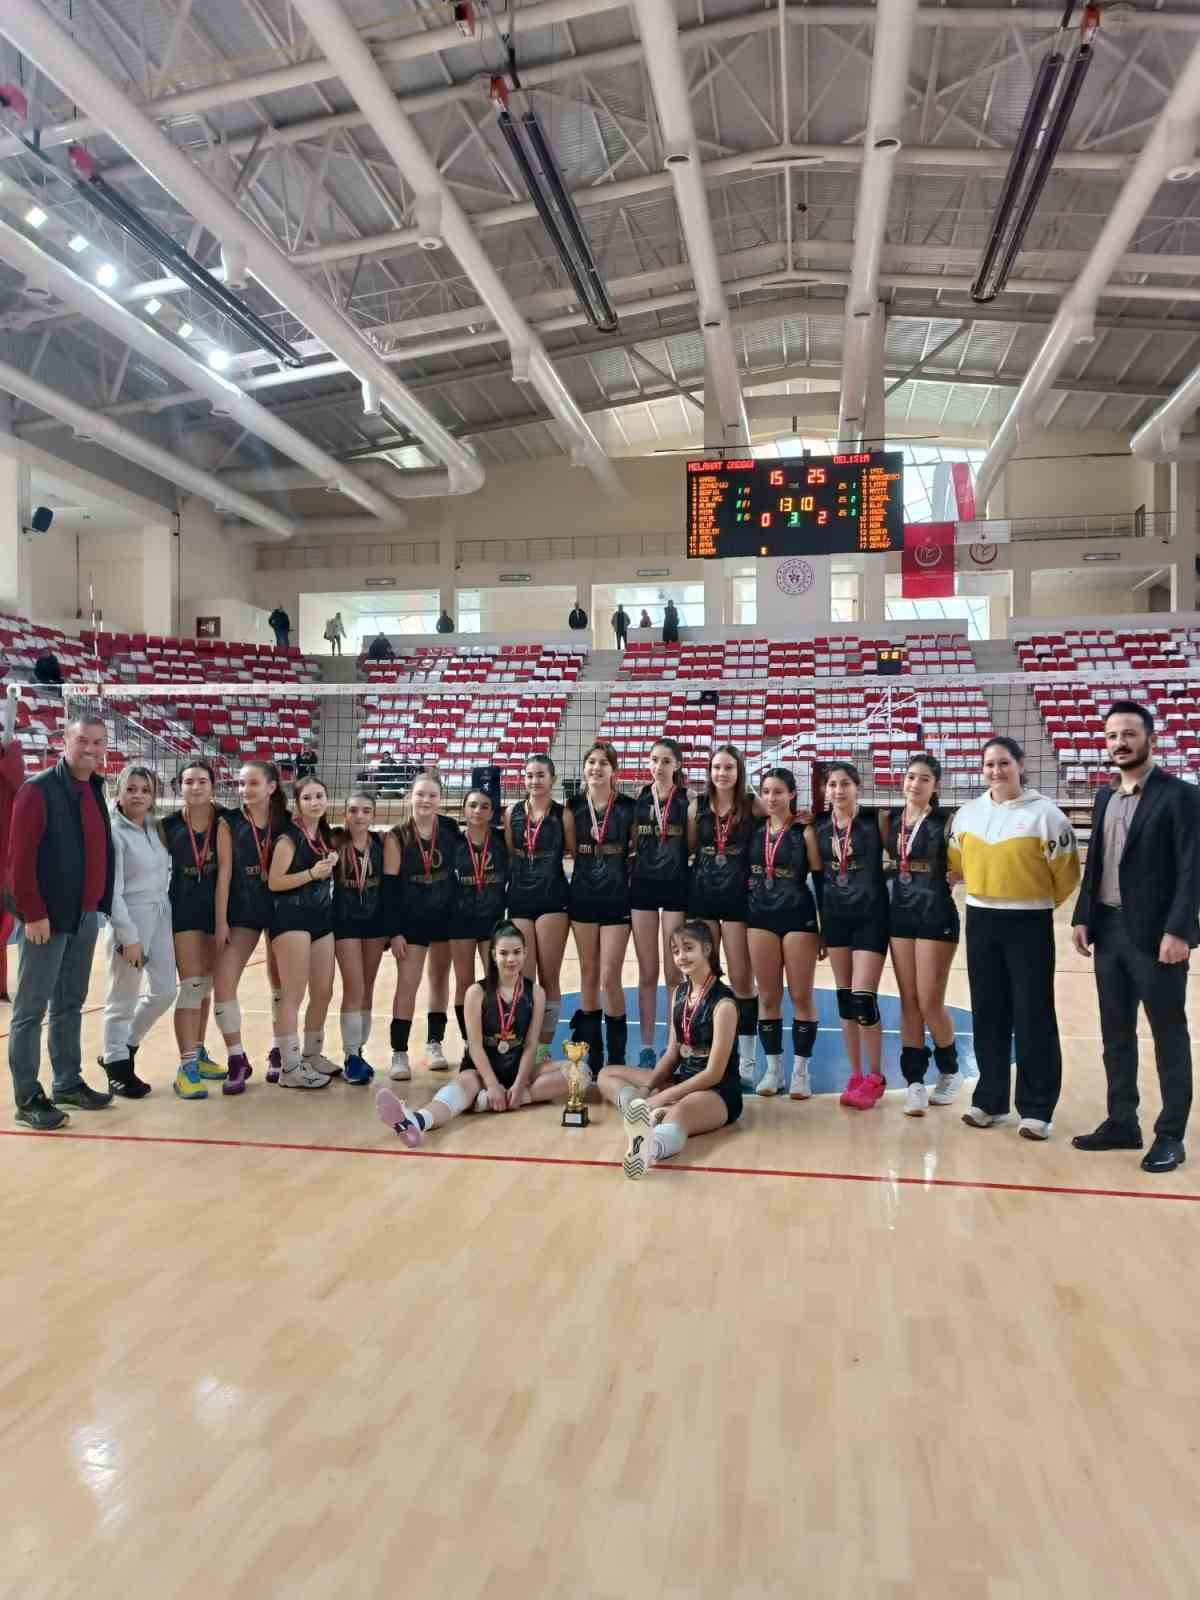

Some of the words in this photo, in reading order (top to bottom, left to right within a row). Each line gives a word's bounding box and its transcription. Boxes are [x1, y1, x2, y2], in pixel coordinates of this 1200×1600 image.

[769, 470, 784, 486] 15
[807, 468, 825, 484] 25
[779, 497, 793, 512] 13
[800, 496, 814, 511] 10
[761, 512, 771, 527] 0
[790, 511, 799, 524] 3
[818, 511, 827, 525] 2
